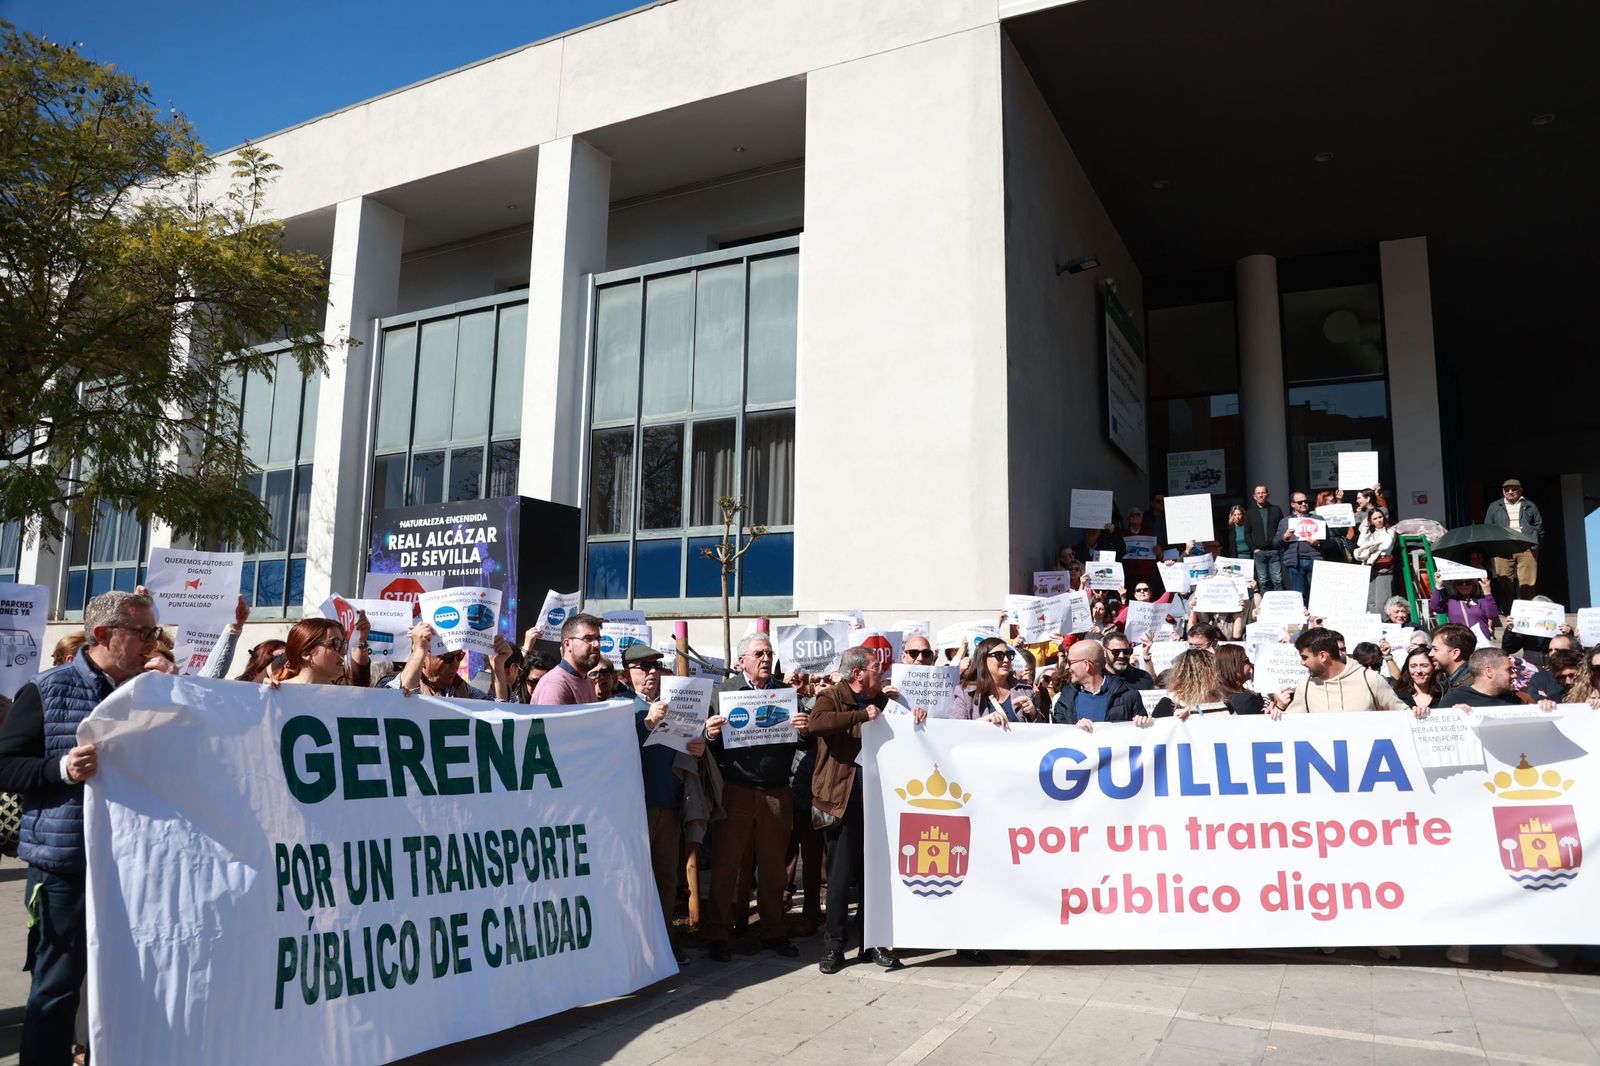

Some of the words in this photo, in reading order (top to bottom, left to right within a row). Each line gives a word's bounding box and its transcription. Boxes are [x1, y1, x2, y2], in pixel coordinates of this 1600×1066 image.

[400, 517, 444, 528] NATURALEZA
[445, 513, 487, 524] ENCENDIDA
[388, 532, 422, 550] REAL
[425, 525, 497, 547] ALCÁZAR
[164, 557, 201, 566] QUEREMOS
[400, 551, 418, 567] DE
[421, 547, 481, 566] SEVILLA
[448, 567, 483, 576] TREASURE
[0, 600, 34, 609] PARCHES
[796, 640, 832, 658] STOP
[907, 671, 930, 679] TORRE
[905, 689, 950, 697] TRANSPORTE
[1412, 726, 1434, 734] REINA
[1418, 734, 1465, 743] TRANSPORTE
[280, 714, 563, 804] GERENA
[1038, 738, 1414, 801] GUILLENA
[1008, 825, 1088, 865] por
[1107, 824, 1167, 852] un
[1186, 812, 1452, 858] transporte
[276, 842, 336, 912] POR
[343, 838, 395, 906] UN
[402, 823, 591, 898] TRANSPORTE
[1060, 873, 1241, 925] público
[1260, 871, 1404, 921] digno
[274, 916, 421, 1011] PÚBLICO
[430, 913, 473, 980] DE
[481, 895, 593, 969] CALIDAD
